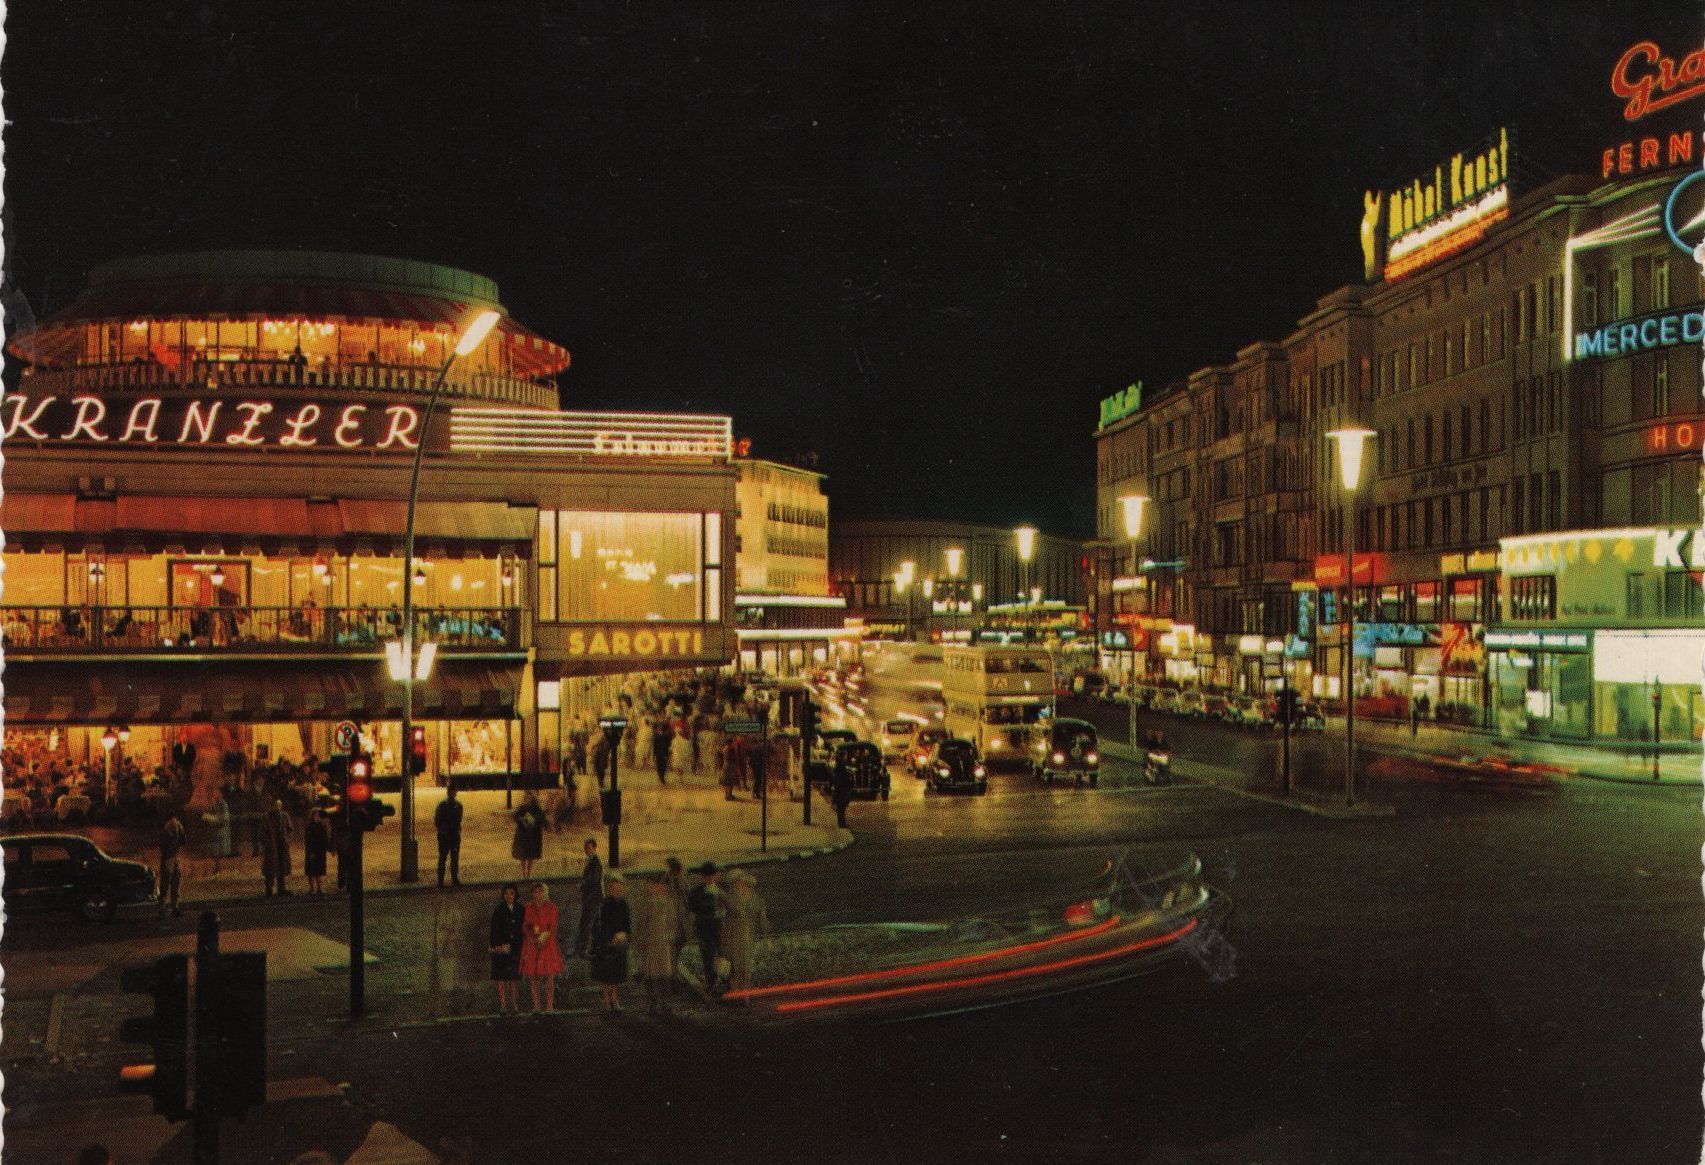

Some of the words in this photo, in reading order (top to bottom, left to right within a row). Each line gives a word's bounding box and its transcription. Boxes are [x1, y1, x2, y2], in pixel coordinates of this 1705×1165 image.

[1576, 312, 1704, 358] MERCED
[4, 396, 421, 450] KRANZLER
[1652, 423, 1694, 450] HO
[568, 629, 702, 656] SAROTTI
